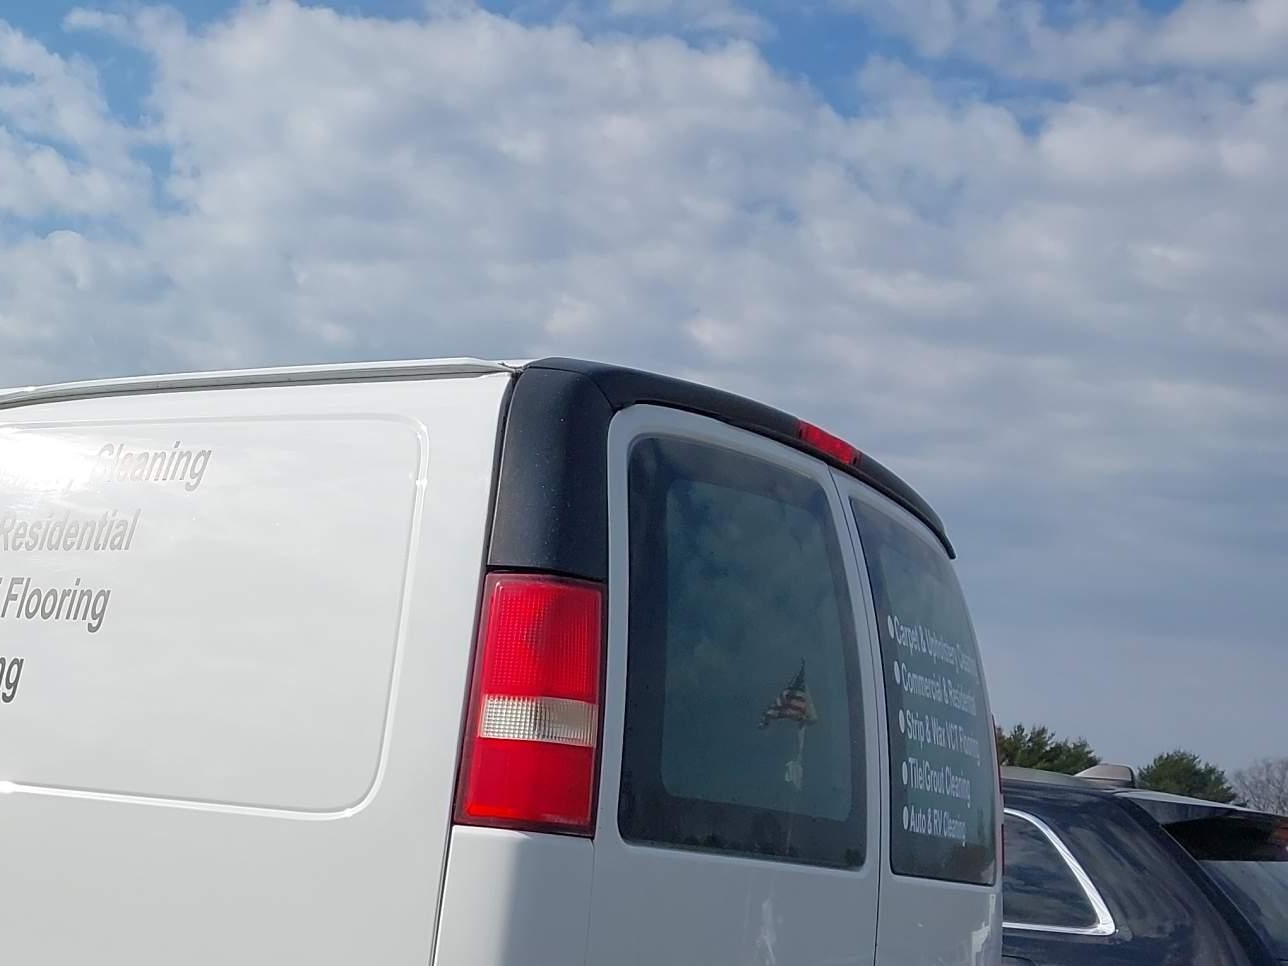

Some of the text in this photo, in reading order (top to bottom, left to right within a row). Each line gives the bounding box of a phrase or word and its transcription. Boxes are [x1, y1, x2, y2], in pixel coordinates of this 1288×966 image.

[98, 441, 212, 491] Cleaning
[1, 577, 111, 633] Flooring
[906, 709, 924, 750] Strip
[925, 715, 932, 744] &
[931, 717, 946, 749] Wax
[908, 757, 945, 796] Tile/Grout
[909, 805, 927, 834] Auto
[927, 808, 933, 836] &
[933, 808, 943, 837] RV
